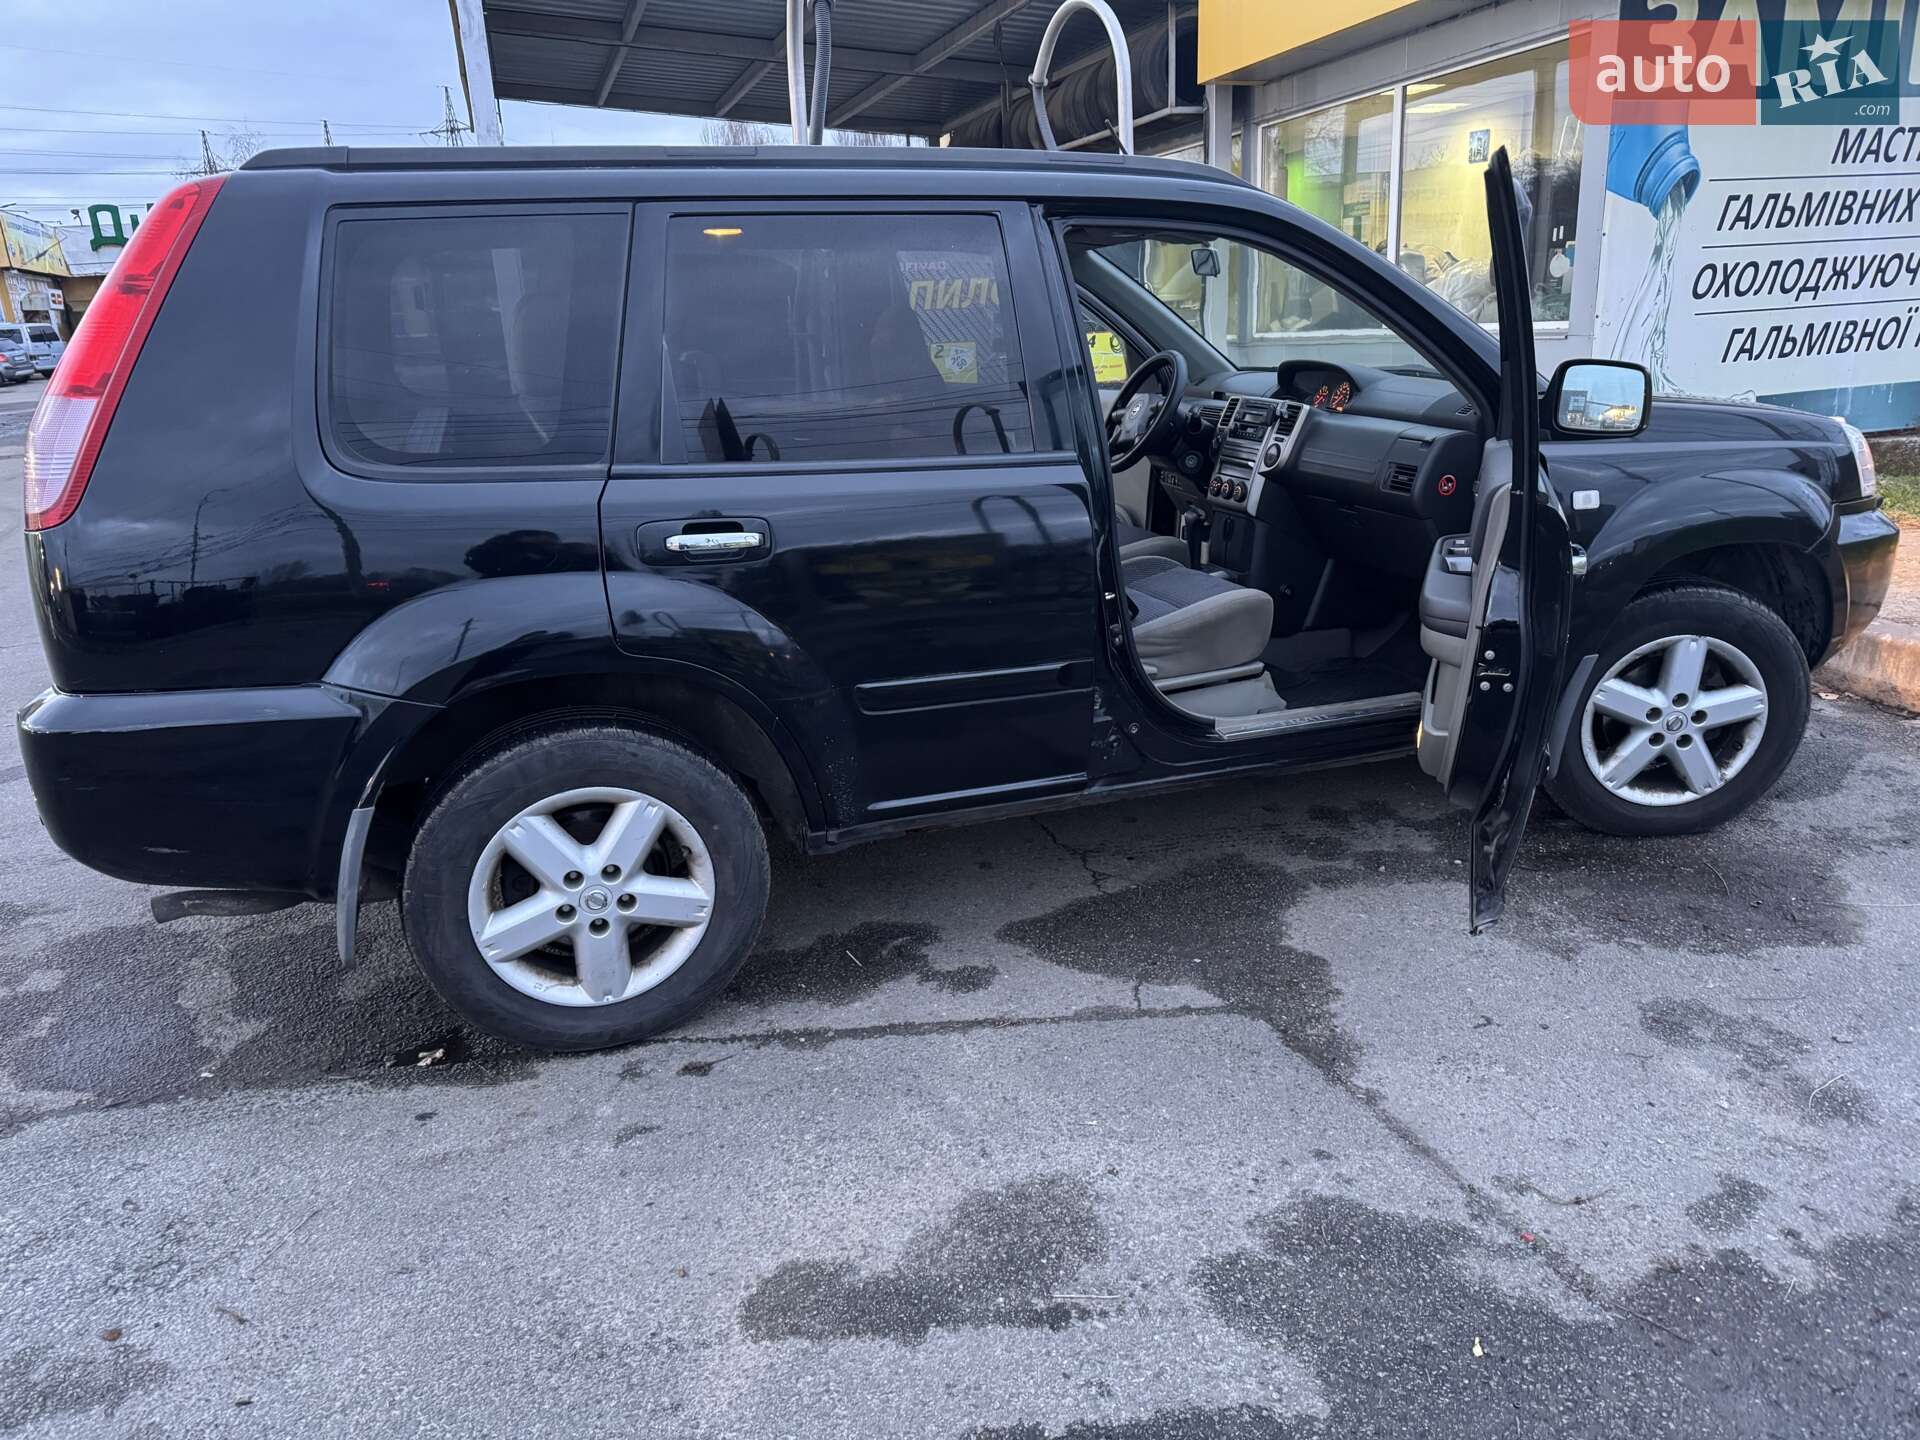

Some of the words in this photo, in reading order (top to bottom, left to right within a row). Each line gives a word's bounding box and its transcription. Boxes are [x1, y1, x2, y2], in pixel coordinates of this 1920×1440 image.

[1647, 0, 1920, 89] ЗАМІ
[1831, 126, 1920, 165] МАСТ
[1716, 187, 1920, 232] ГАЛЬМІВНИХ
[1691, 251, 1920, 302] ОХОЛОДЖУЮЧ
[1720, 305, 1920, 364] ГАЛЬМІВНОЇ
